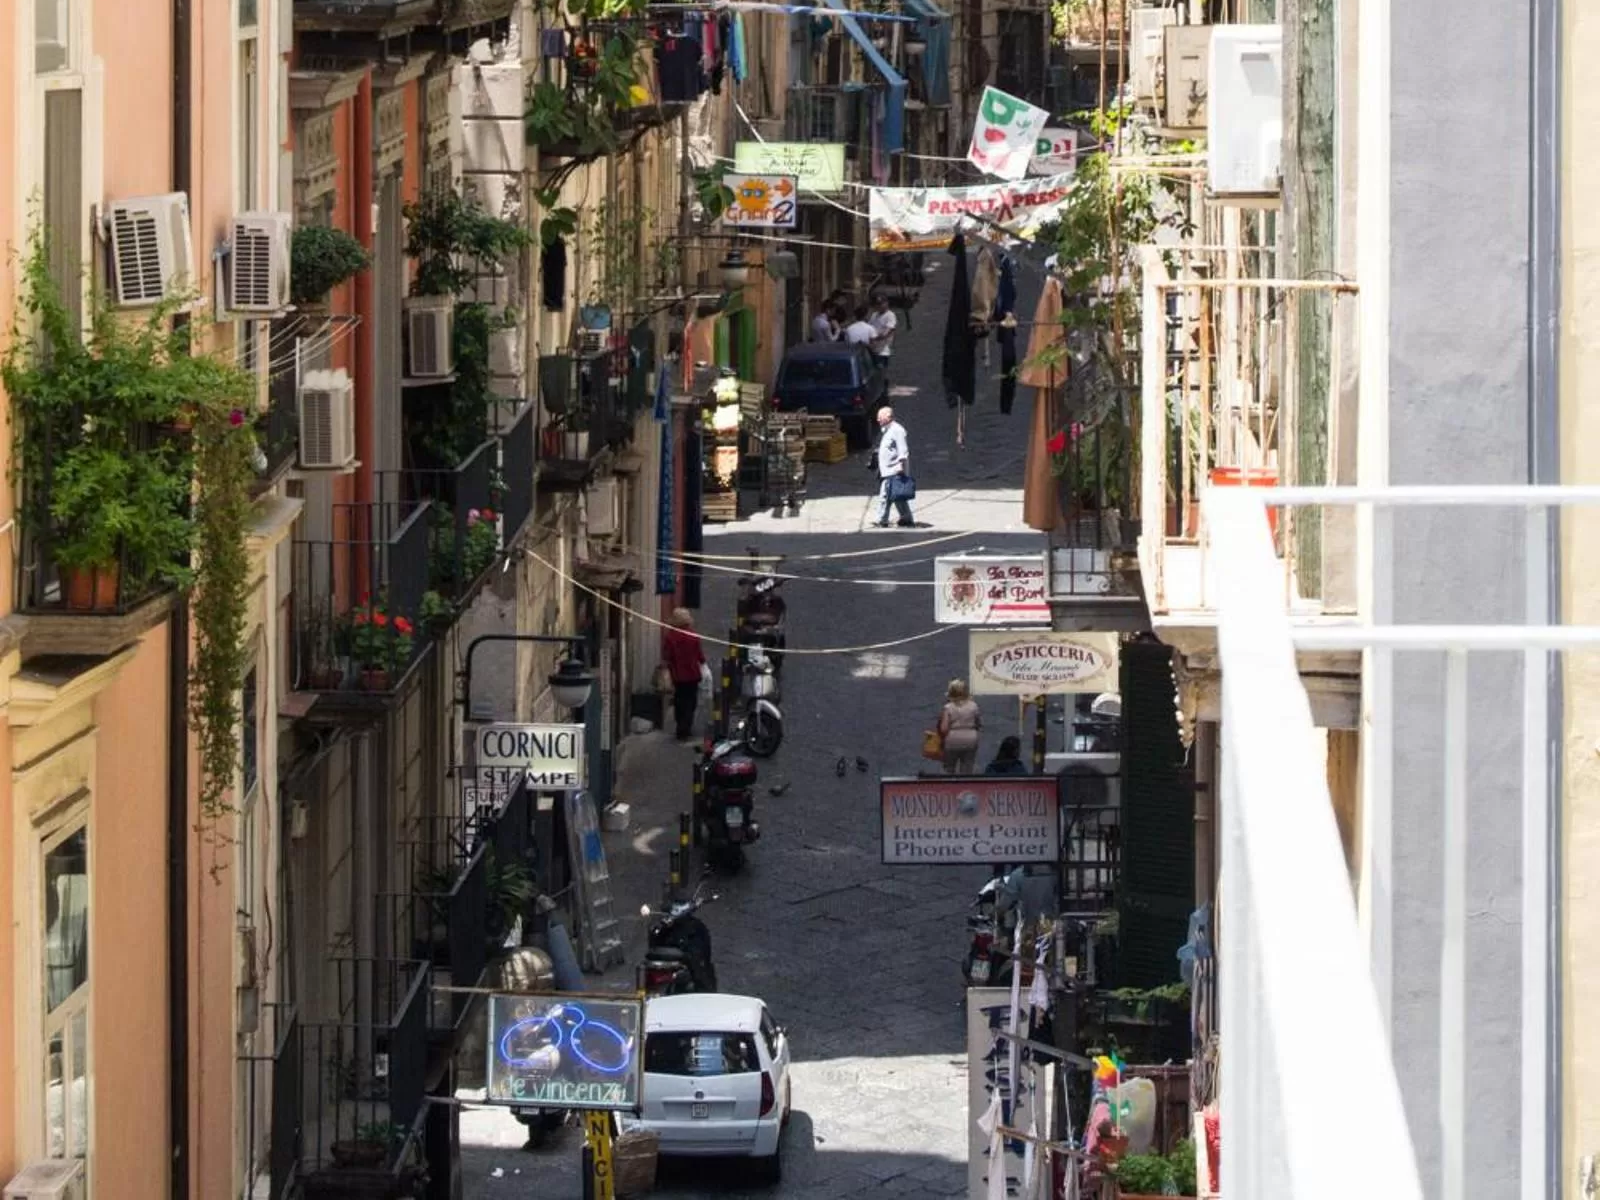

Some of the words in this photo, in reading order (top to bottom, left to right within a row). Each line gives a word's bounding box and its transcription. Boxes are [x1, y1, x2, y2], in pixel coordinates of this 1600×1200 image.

[992, 645, 1096, 669] PASTICCERIA
[483, 730, 575, 759] CORNICI
[892, 792, 951, 818] MONDO
[987, 790, 1048, 817] SERVIZI
[894, 824, 979, 840] Internet
[989, 824, 1048, 839] Point
[895, 842, 965, 857] Phone
[972, 840, 1049, 857] Center
